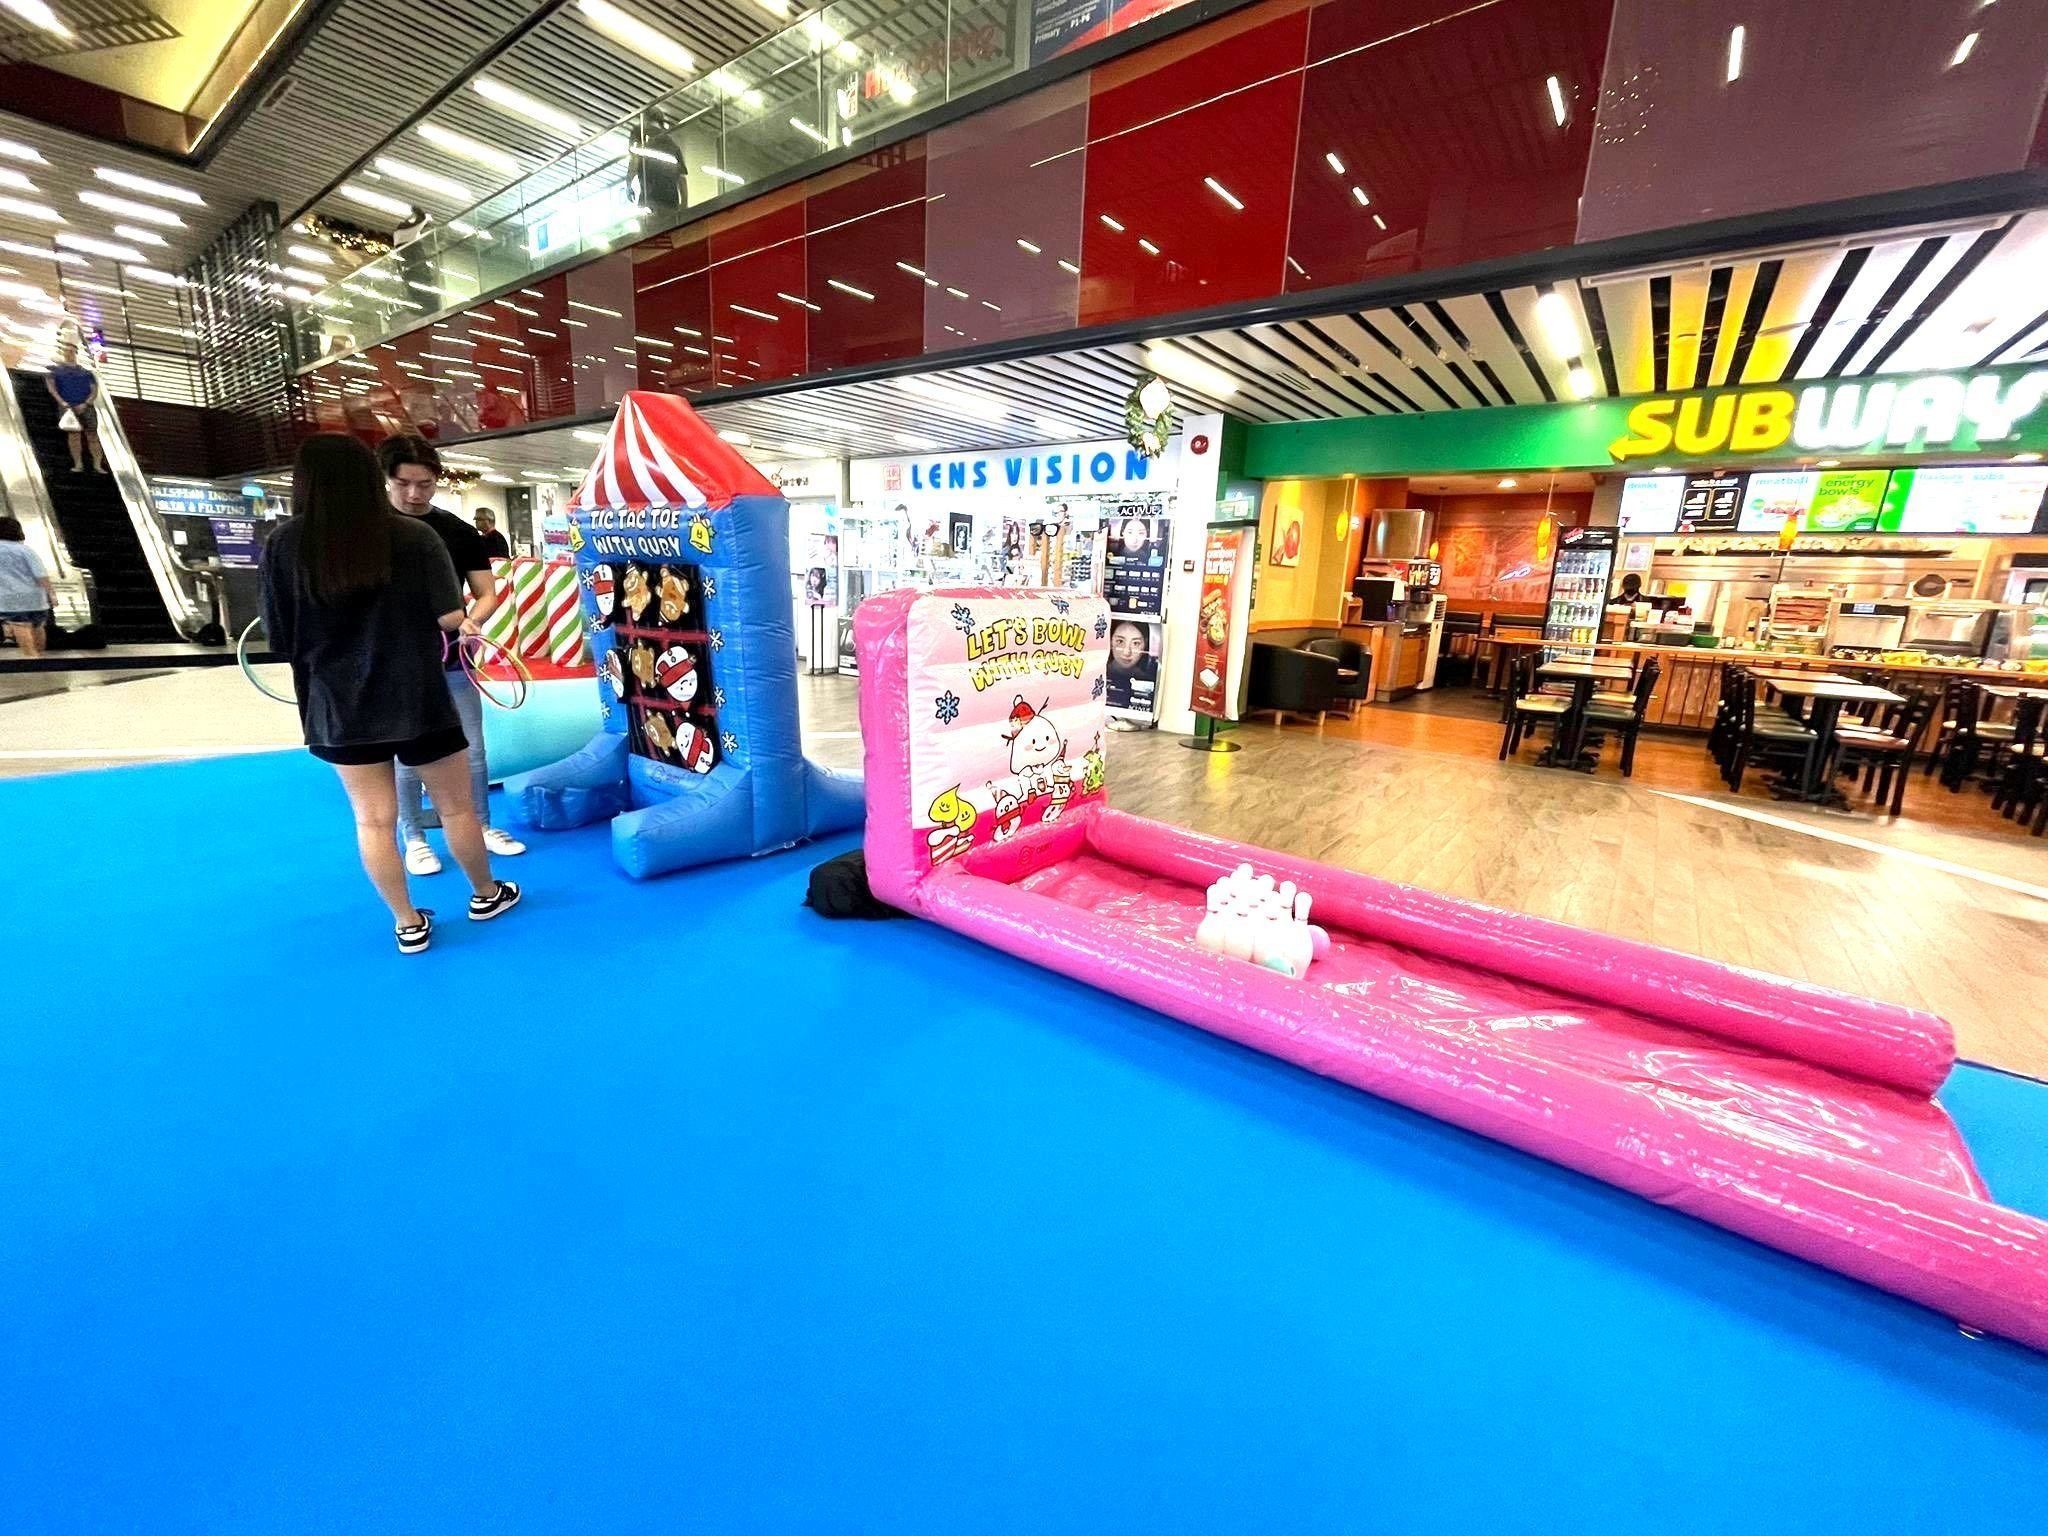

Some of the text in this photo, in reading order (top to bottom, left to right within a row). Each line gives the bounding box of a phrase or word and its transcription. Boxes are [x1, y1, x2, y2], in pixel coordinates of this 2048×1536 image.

[1608, 369, 2048, 461] SUBWAY
[911, 460, 987, 490] LENS
[1004, 449, 1148, 487] VISION
[1825, 478, 1874, 488] energy
[590, 507, 681, 530] TIC TAC TOE
[1120, 506, 1157, 516] ACUVUE
[592, 535, 681, 557] WITH QUBY
[967, 616, 1086, 660] LET'S BOWL
[970, 649, 1084, 691] WITH QUBY
